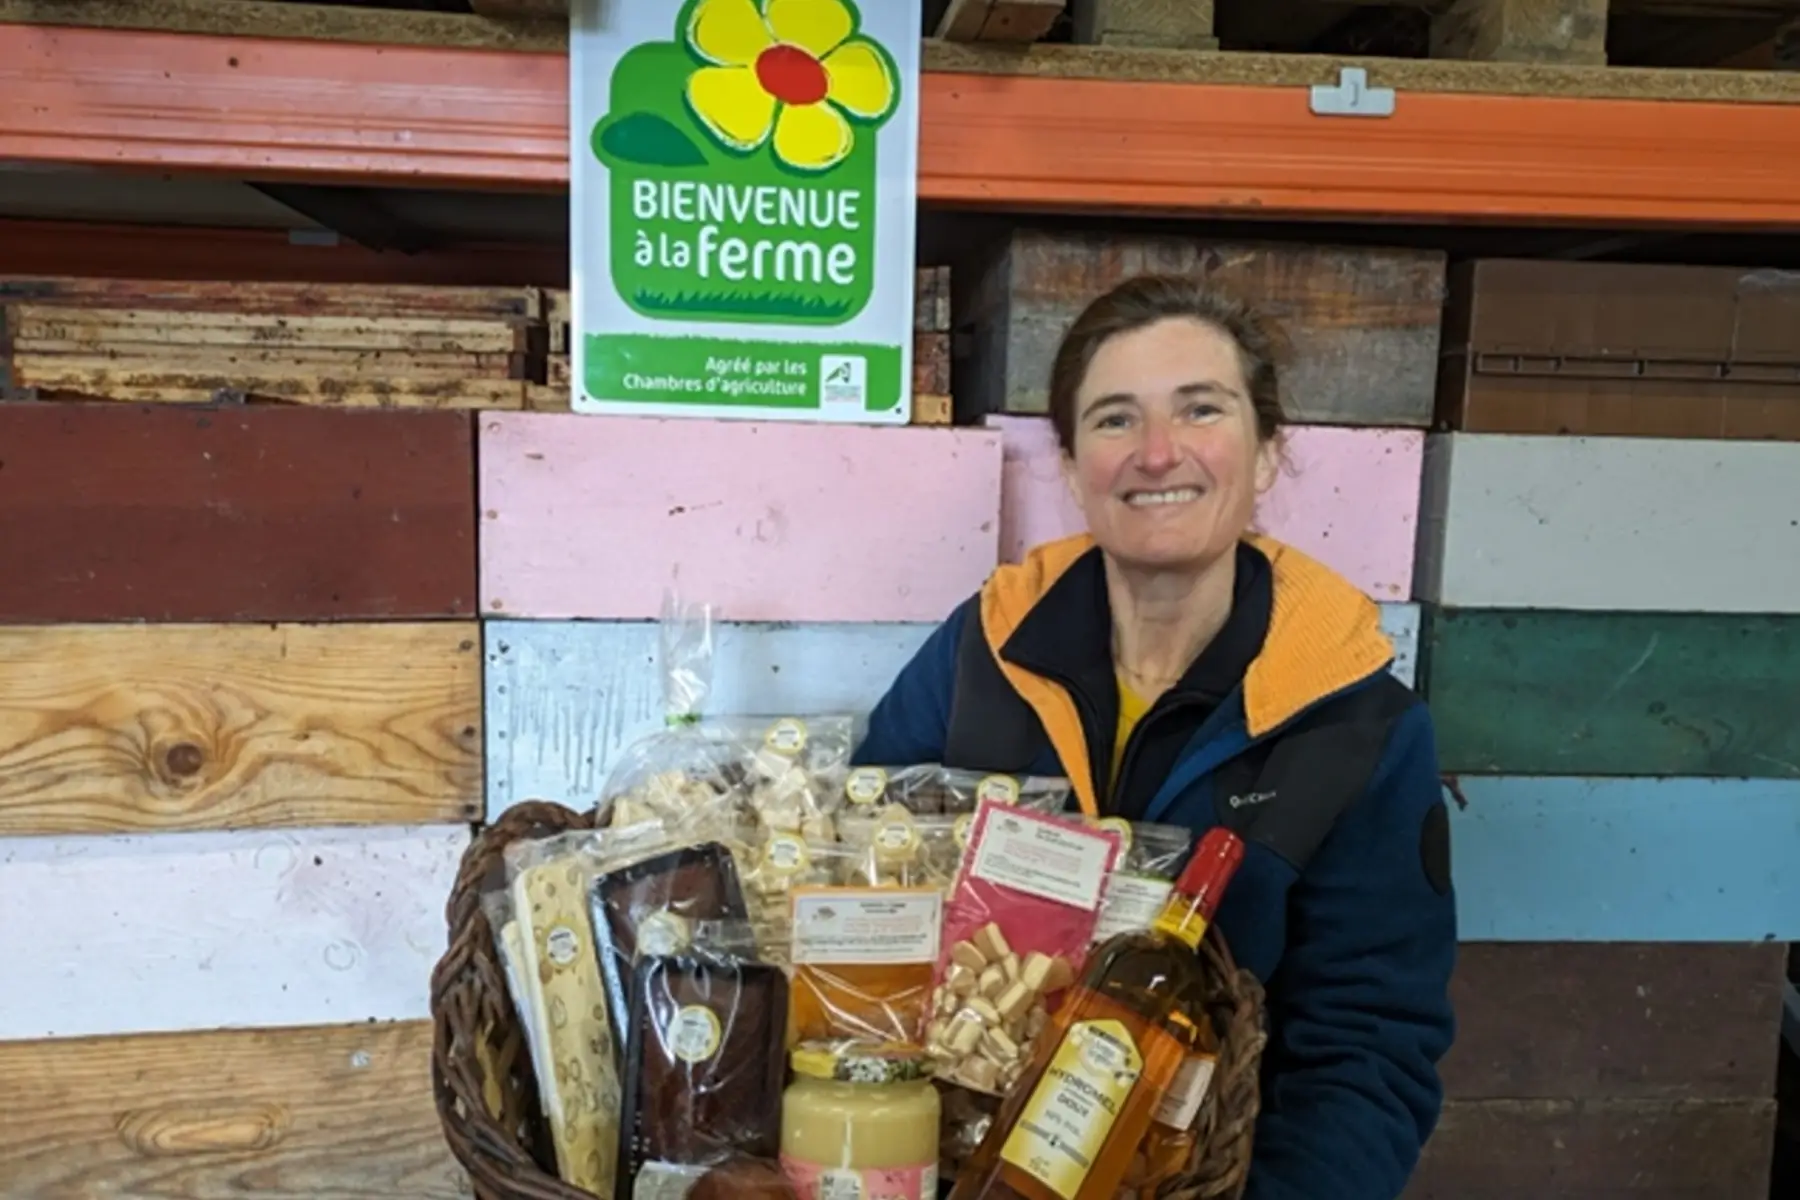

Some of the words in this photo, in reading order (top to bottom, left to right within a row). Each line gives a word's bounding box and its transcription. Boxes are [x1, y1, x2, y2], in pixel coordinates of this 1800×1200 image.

[633, 179, 861, 230] BIENVENUE
[634, 229, 653, 267] à
[660, 232, 691, 268] la
[697, 224, 857, 284] ferme
[623, 373, 703, 393] Chambres
[705, 377, 807, 397] d'agriculture
[705, 356, 752, 376] Agréé
[755, 360, 781, 377] par
[784, 359, 807, 375] les
[1049, 1066, 1116, 1115] HYDROMEL
